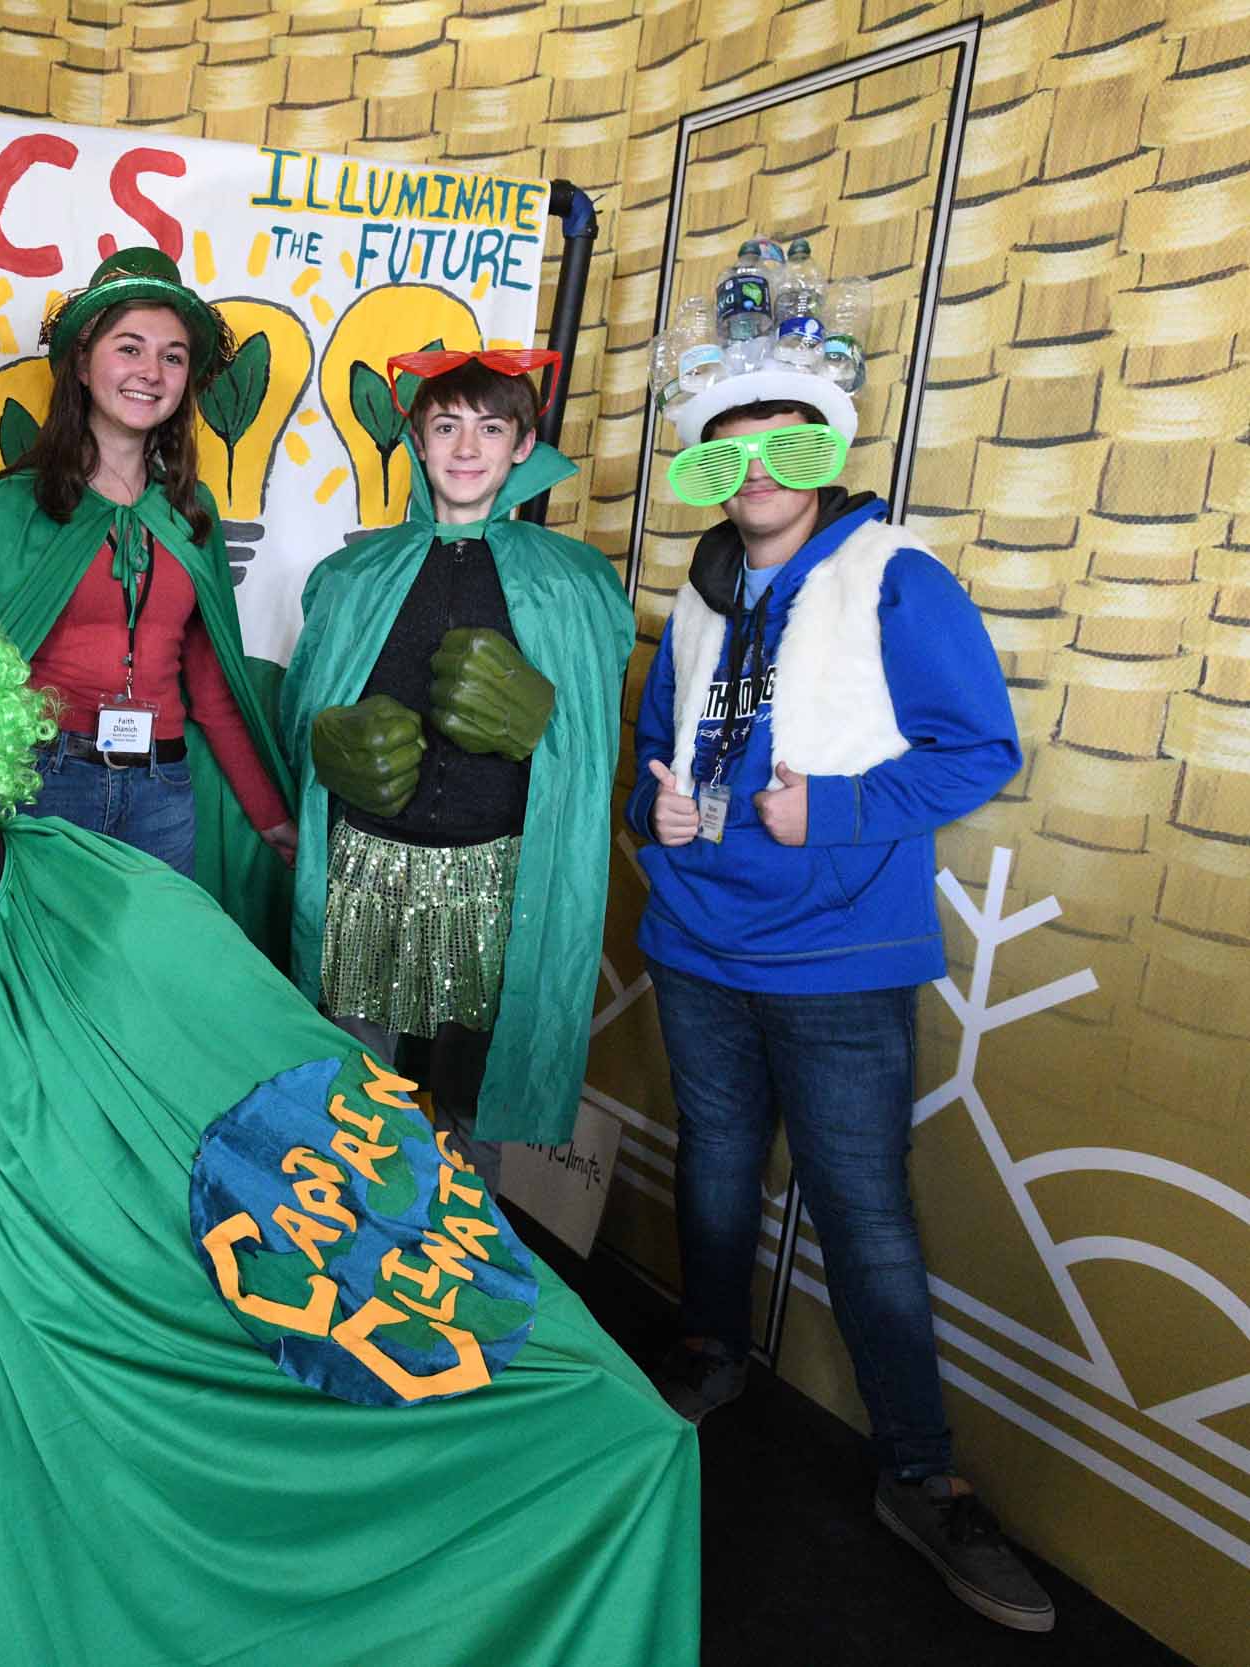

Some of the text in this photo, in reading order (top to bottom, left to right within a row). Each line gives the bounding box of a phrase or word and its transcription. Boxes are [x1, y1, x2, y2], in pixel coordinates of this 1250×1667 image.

[251, 146, 547, 231] ILLUMINATE
[271, 223, 539, 291] THE FUTURE
[118, 717, 135, 725] Faith
[201, 1052, 419, 1336] CAPTAIN
